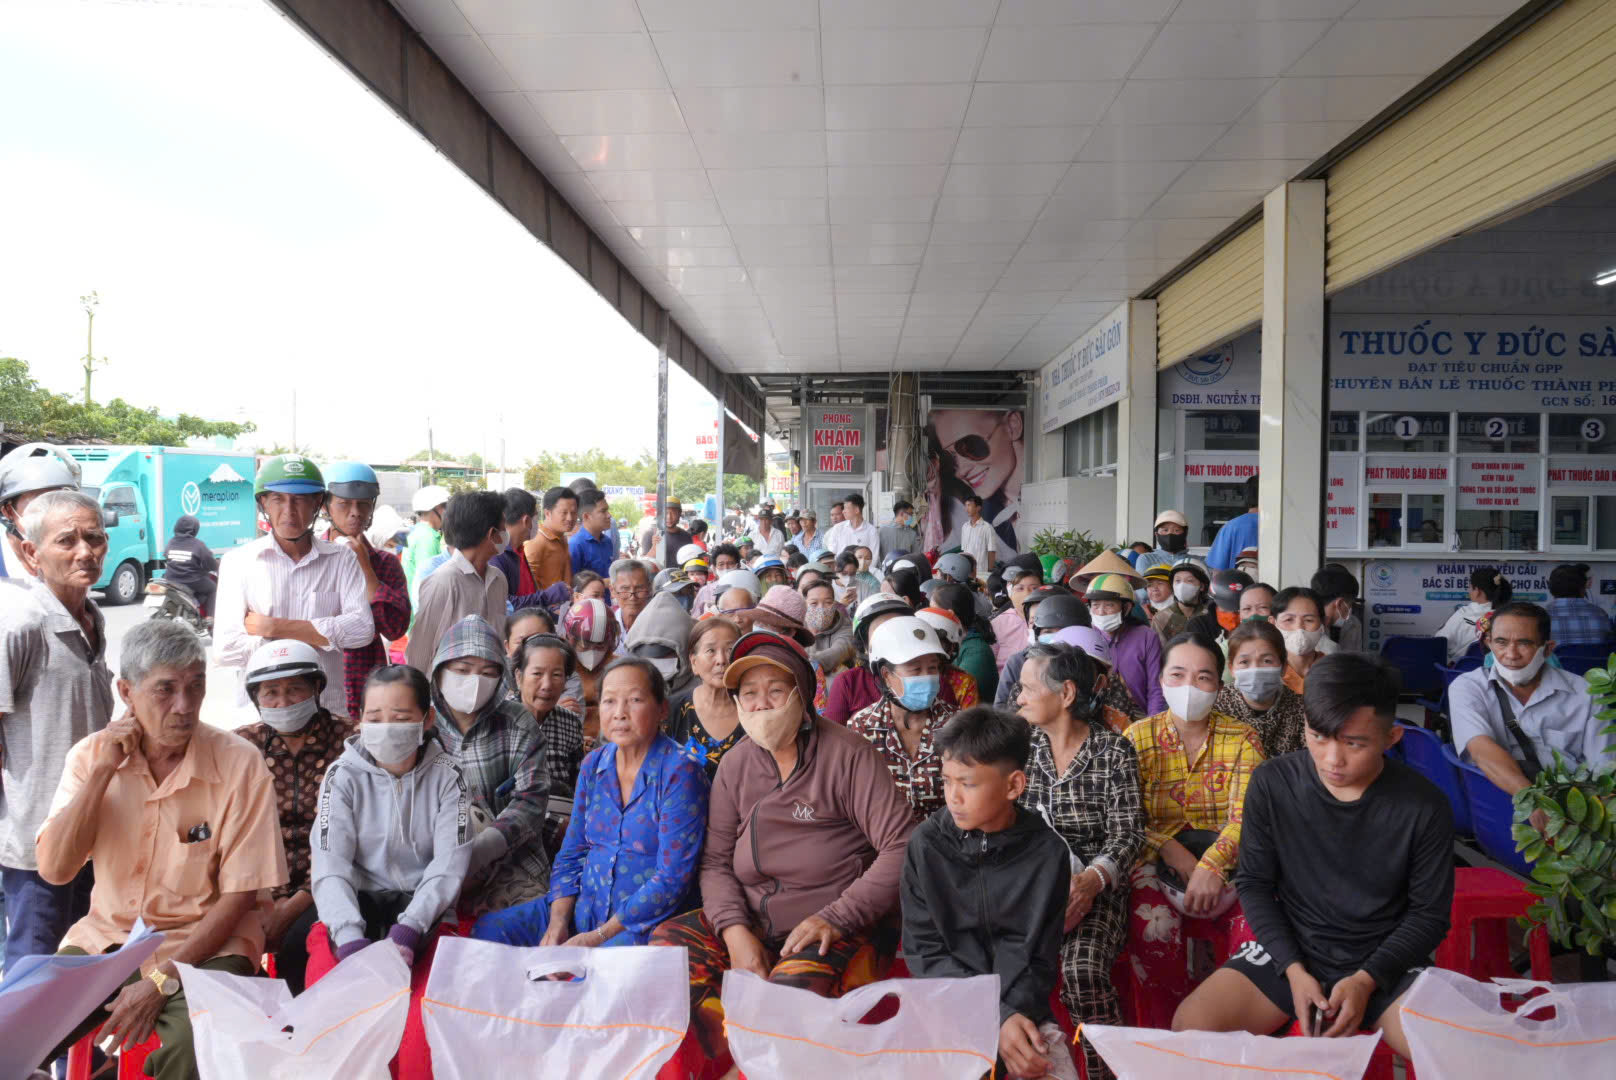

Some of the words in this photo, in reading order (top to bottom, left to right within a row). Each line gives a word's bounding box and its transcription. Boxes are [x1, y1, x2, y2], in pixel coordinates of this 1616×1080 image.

[1339, 319, 1453, 355] THUỐC
[1463, 331, 1487, 355] Y
[1496, 325, 1566, 356] ĐỨC
[1578, 326, 1616, 356] SÀ
[1408, 363, 1437, 375] ĐẠT
[1442, 360, 1476, 373] TIÊU
[1481, 358, 1530, 373] CHUẨN
[1535, 363, 1563, 374] GPP
[1399, 376, 1433, 390] BÁN
[1467, 375, 1525, 391] THUỐC
[1533, 377, 1592, 391] THÀNH
[1599, 380, 1616, 392] PH
[1172, 393, 1203, 404] DSĐH.
[1206, 389, 1247, 405] NGUYỄN
[1250, 394, 1262, 405] TH
[1541, 396, 1569, 407] GCN
[1601, 394, 1616, 406] 16
[822, 411, 852, 423] PHÒNG
[1401, 420, 1412, 436] 1
[1489, 421, 1504, 438] 2
[1585, 421, 1600, 439] 3
[814, 426, 861, 447] KHÁM
[818, 450, 854, 472] MẮT
[1207, 461, 1233, 477] THUỐC
[1365, 465, 1384, 479] PHÁT
[1386, 464, 1411, 479] THUỐC
[1429, 463, 1448, 480] HIỂM
[1548, 467, 1566, 481] PHÁT
[1568, 466, 1593, 482] THUỐC
[770, 476, 792, 490] THU
[1437, 561, 1465, 574] KHÁM
[1517, 562, 1537, 575] CẦU
[1422, 576, 1442, 588] BÁC
[1444, 576, 1455, 588] SĨ
